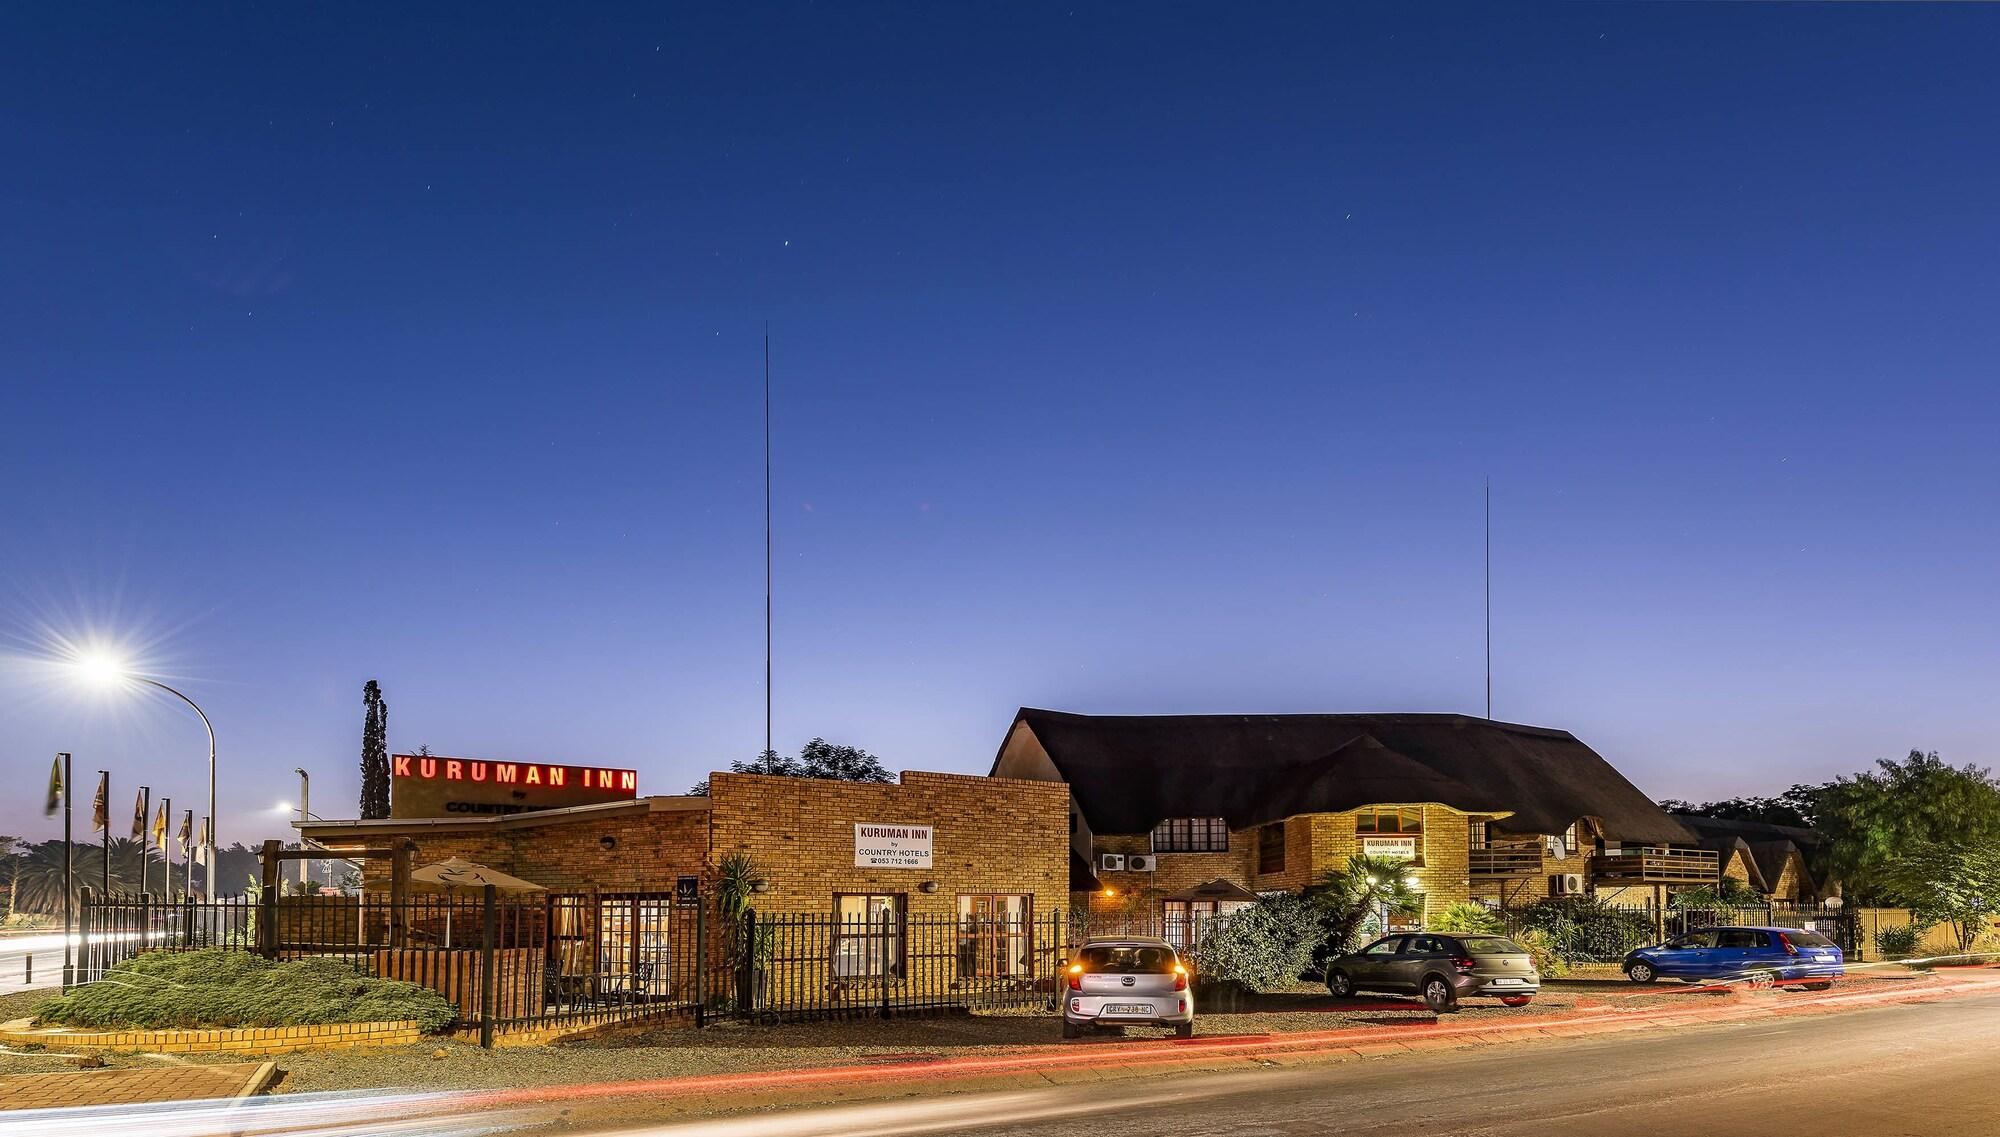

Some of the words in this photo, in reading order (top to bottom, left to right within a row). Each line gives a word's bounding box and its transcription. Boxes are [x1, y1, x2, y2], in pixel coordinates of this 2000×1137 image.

[395, 756, 564, 786] KURUMAN
[584, 769, 635, 790] INN
[861, 828, 908, 839] KURUMAN
[911, 829, 928, 839] INN
[859, 849, 897, 857] COUNTRY
[891, 857, 902, 865] 712
